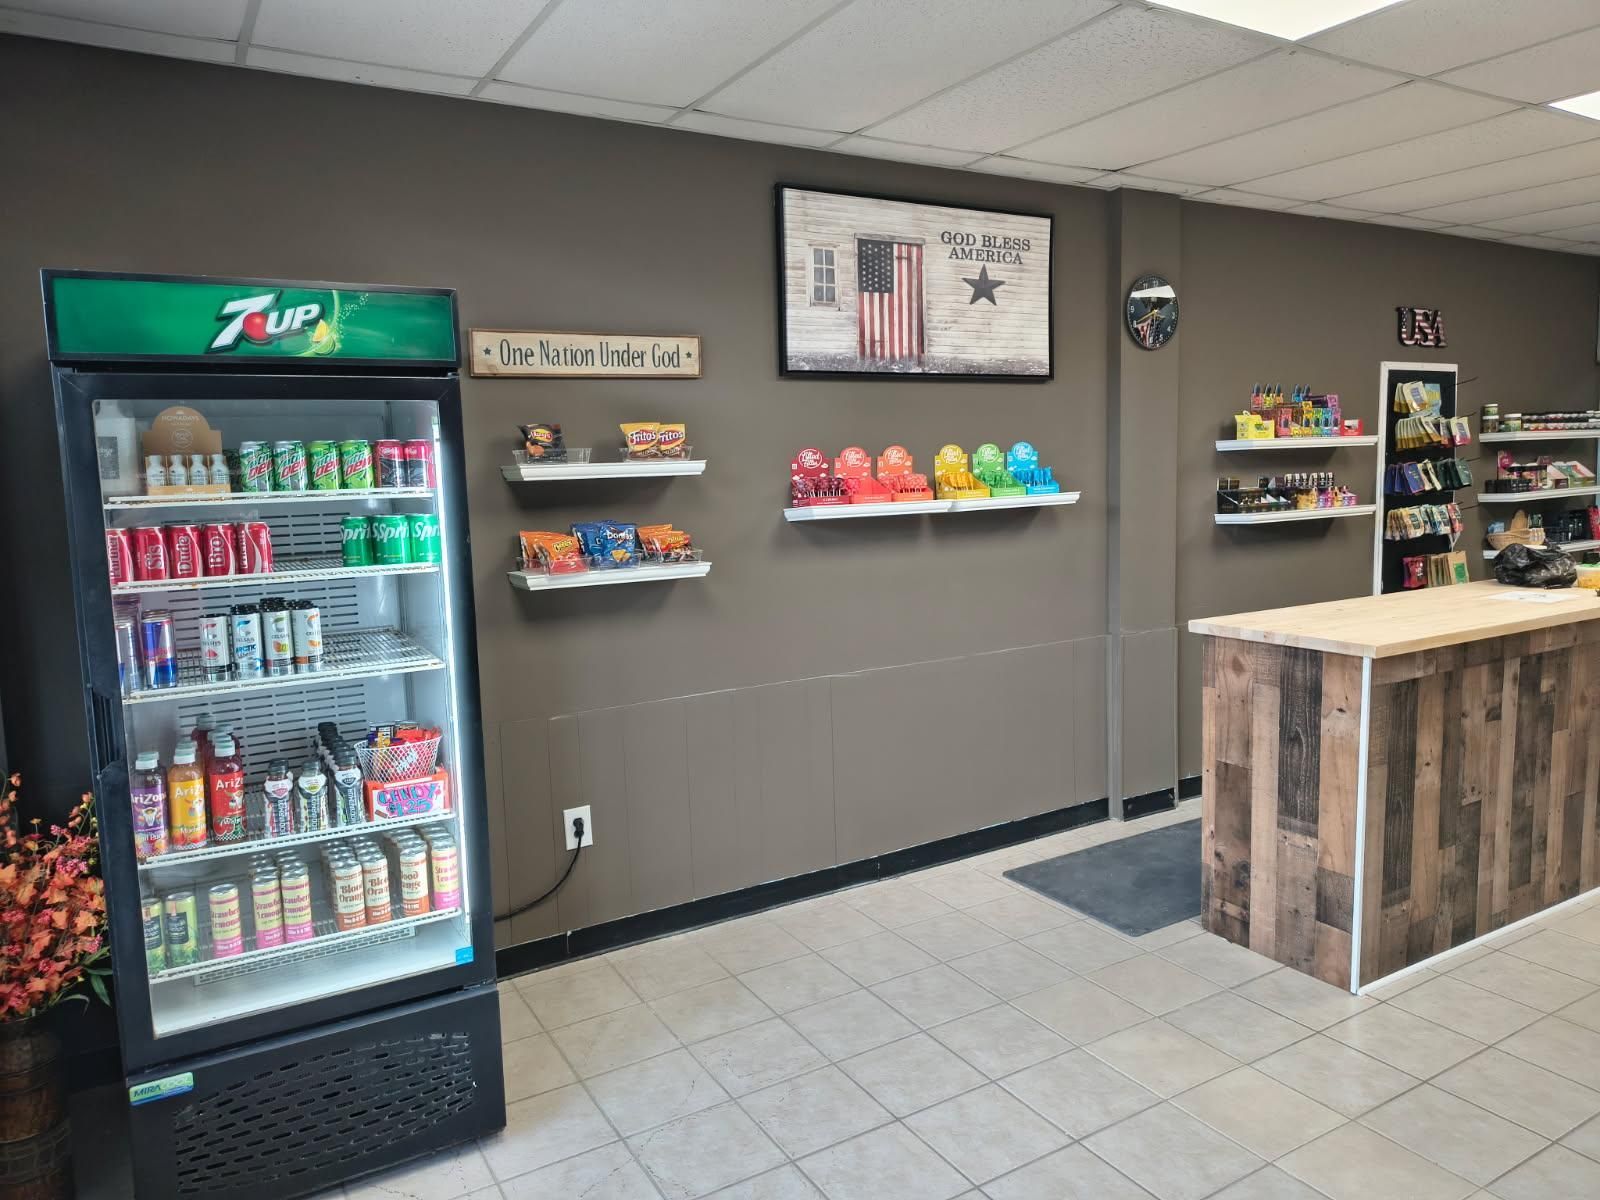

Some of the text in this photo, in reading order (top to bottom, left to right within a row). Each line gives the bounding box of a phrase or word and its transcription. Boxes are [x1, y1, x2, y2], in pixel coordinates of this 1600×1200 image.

[941, 231, 1031, 252] GOD BLESS
[948, 247, 1023, 265] AMERICA
[1396, 307, 1448, 348] USA
[500, 338, 681, 369] One Nation Under God
[629, 430, 656, 445] Fritos
[659, 431, 683, 442] Fritos
[145, 544, 165, 570] Sis
[176, 535, 193, 575] Dude
[208, 535, 224, 569] Bro
[378, 783, 438, 805] CANDY
